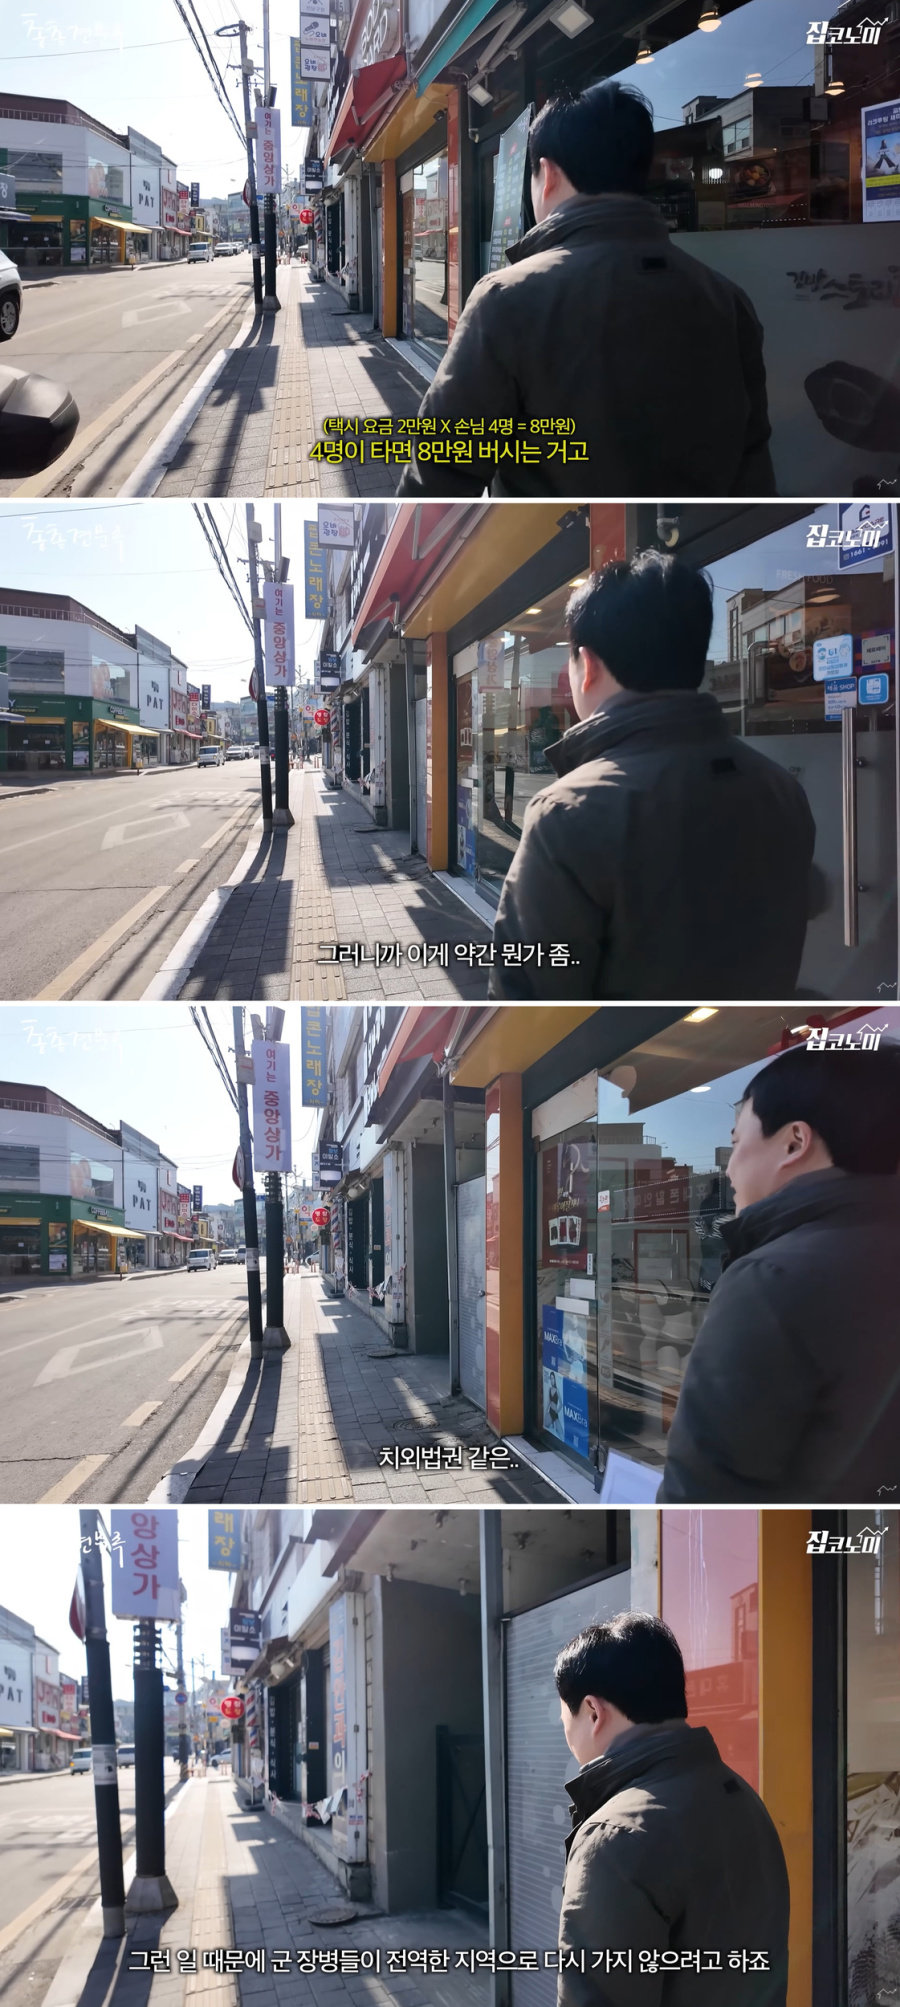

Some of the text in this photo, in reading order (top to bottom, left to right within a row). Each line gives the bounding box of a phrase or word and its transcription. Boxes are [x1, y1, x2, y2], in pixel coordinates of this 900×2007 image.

[264, 112, 272, 135] 여기는
[263, 140, 275, 187] 중앙상가
[138, 193, 154, 208] PAT
[273, 588, 284, 616] 여기는
[273, 621, 288, 677] 중앙상가
[146, 694, 164, 710] PAT
[265, 1048, 277, 1083] 여기는
[263, 1089, 281, 1161] 중앙상가
[133, 1194, 151, 1211] PAT
[130, 1511, 161, 1600] 앙상가
[233, 1624, 257, 1635] 이발소
